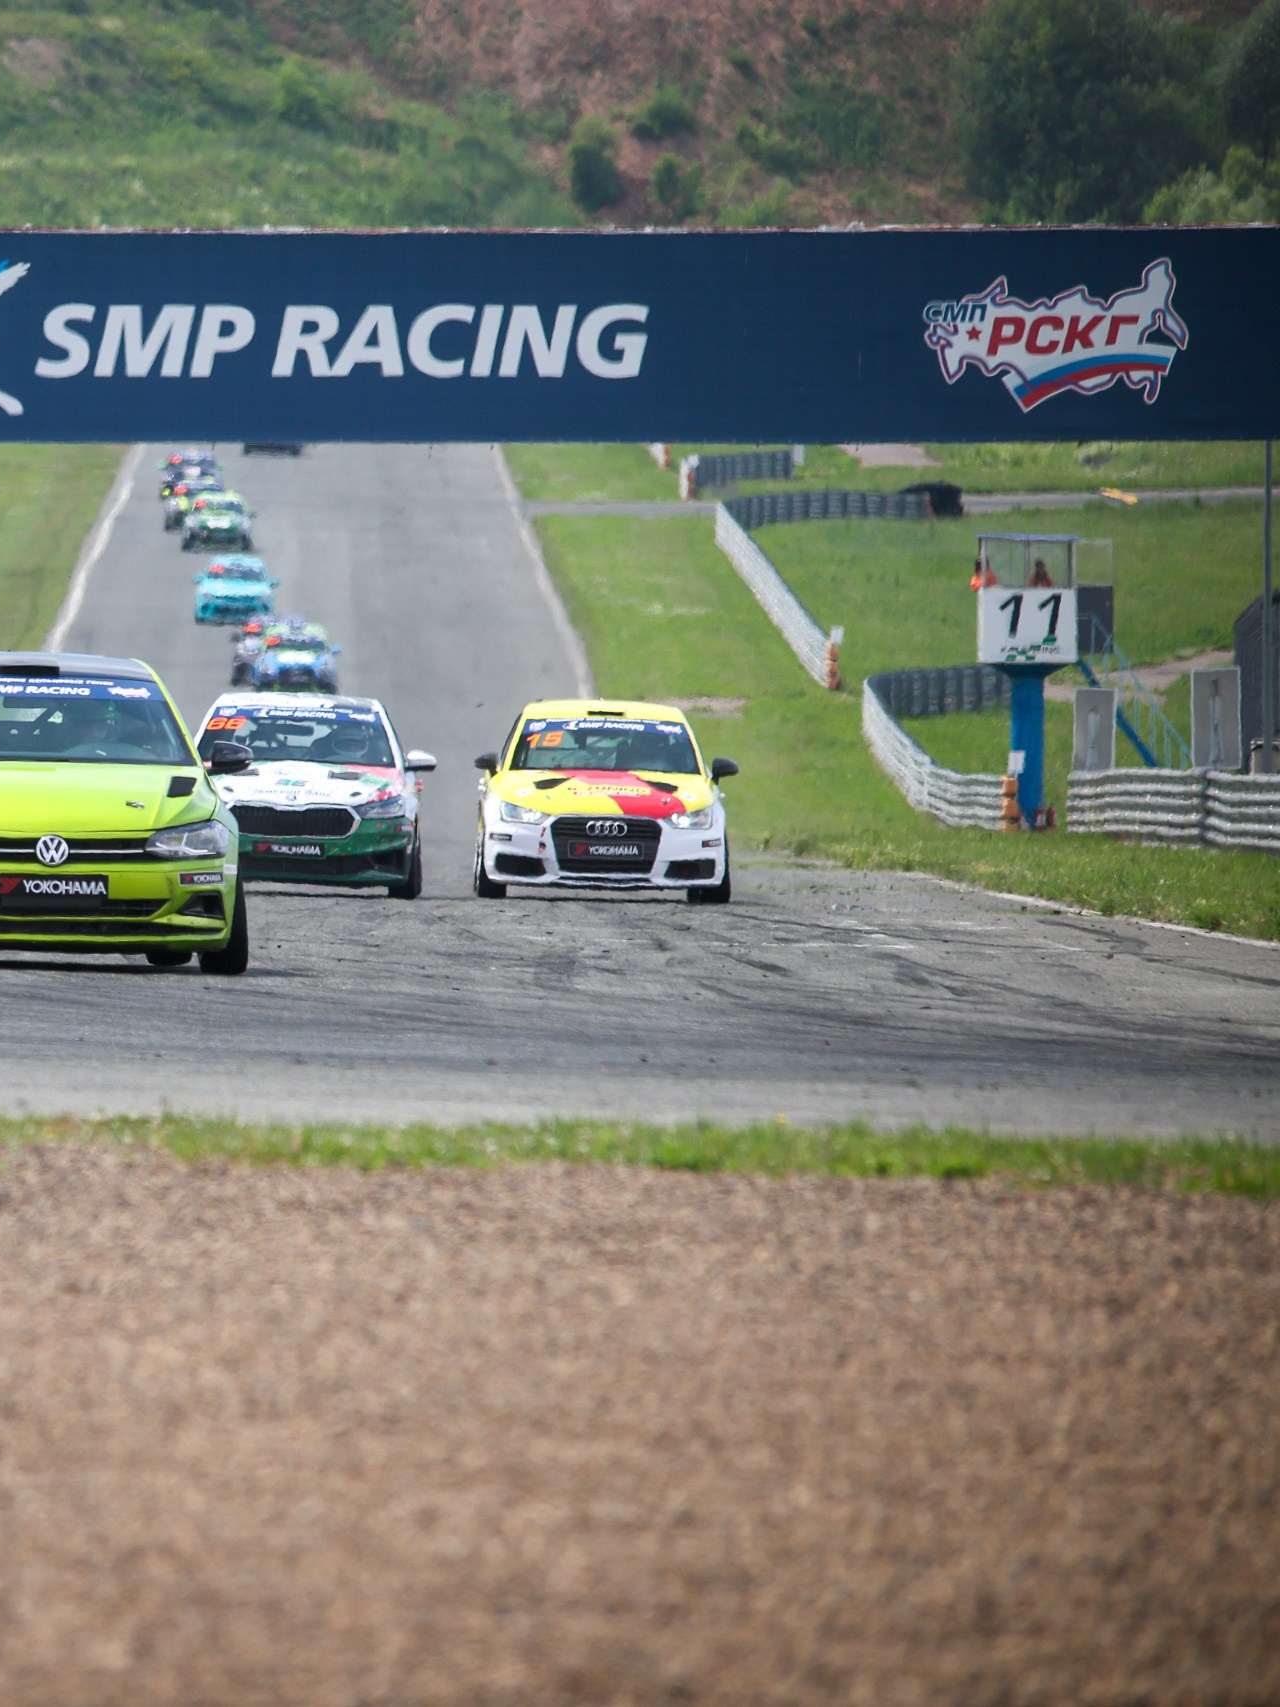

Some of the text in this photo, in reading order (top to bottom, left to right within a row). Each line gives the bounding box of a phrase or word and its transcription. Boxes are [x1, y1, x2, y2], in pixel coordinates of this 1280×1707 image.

[924, 301, 988, 323] СМП
[34, 303, 650, 378] SMP RACING
[986, 314, 1140, 357] РСКГ
[999, 592, 1062, 639] 11
[25, 685, 91, 696] RACING
[206, 716, 247, 731] 66
[526, 731, 564, 749] 15
[270, 844, 321, 856] YOKOHAMA
[588, 846, 639, 856] YOKOHAMA
[23, 879, 107, 895] YOKOHAMA
